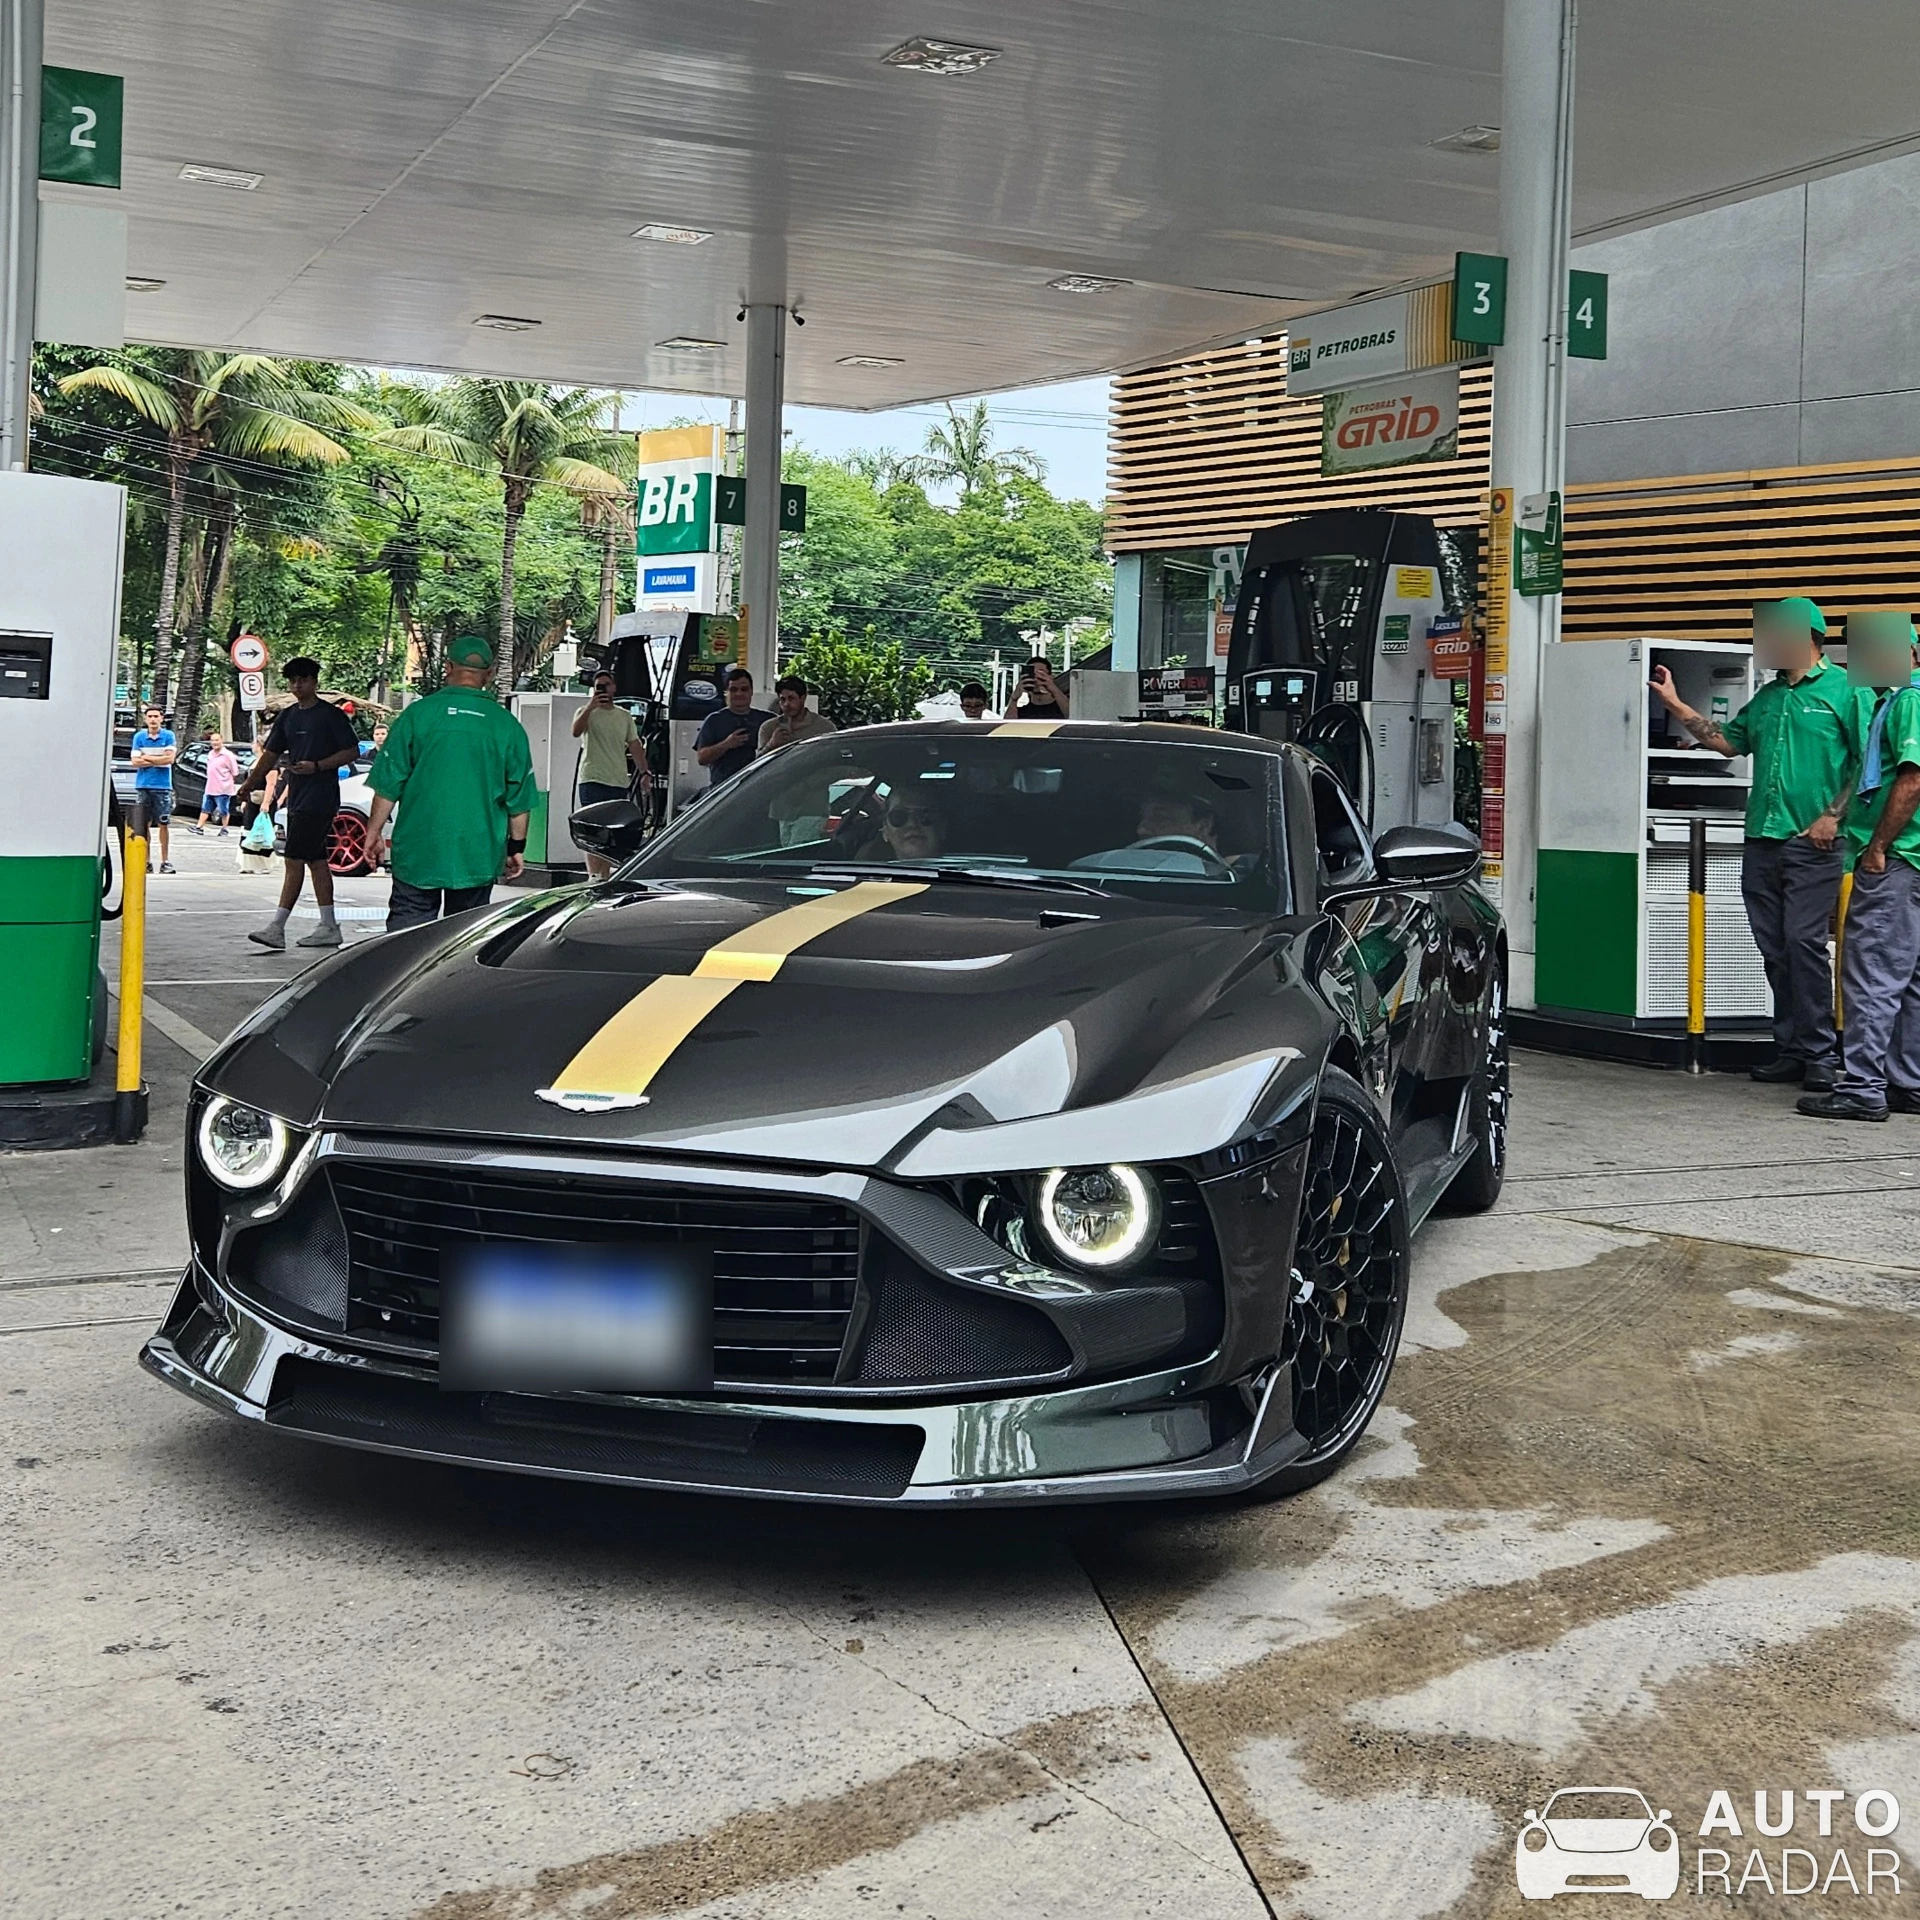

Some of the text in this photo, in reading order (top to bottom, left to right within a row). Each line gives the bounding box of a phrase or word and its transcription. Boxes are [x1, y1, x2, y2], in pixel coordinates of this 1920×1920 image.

[70, 105, 97, 149] 2
[1473, 281, 1491, 315] 3
[1575, 298, 1594, 329] 4
[1293, 329, 1396, 365] BR PETROBRAS
[1350, 399, 1397, 414] PETROBRAS
[1337, 396, 1440, 450] GRID
[639, 470, 699, 527] BR
[726, 491, 737, 509] 7
[787, 499, 798, 516] 8
[651, 574, 687, 586] LAVAMANIA
[1434, 637, 1470, 655] GRID
[248, 679, 256, 691] E
